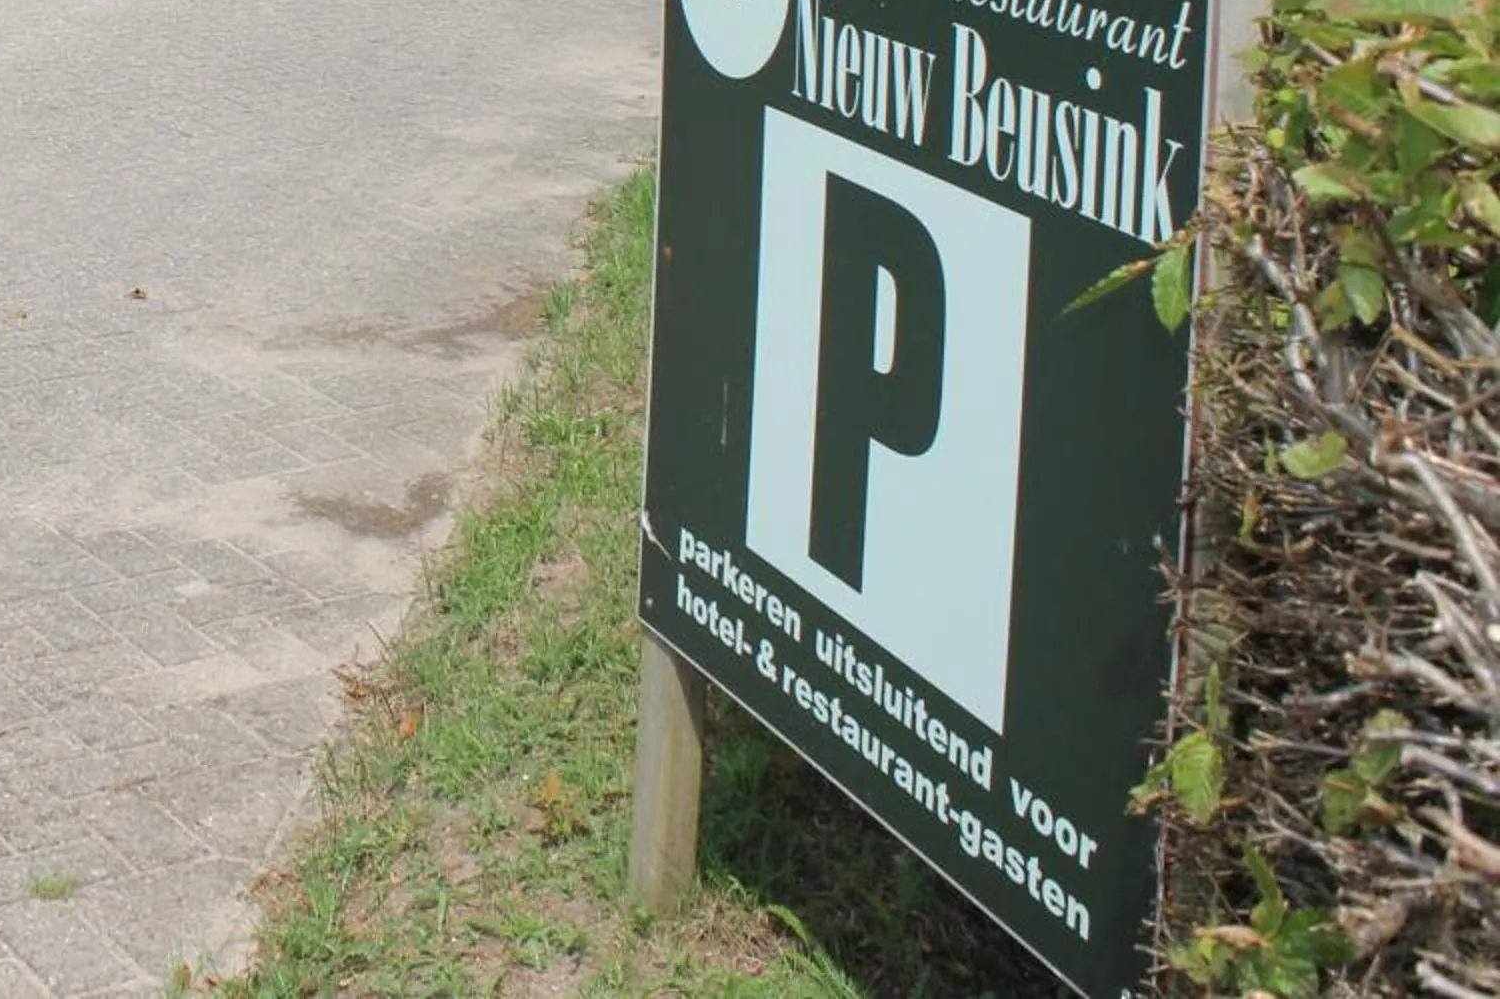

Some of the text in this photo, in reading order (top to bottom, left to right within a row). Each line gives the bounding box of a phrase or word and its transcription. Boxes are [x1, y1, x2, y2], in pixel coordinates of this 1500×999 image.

[948, 21, 1185, 244] Beusink
[808, 170, 947, 595] P
[676, 574, 1091, 942] hotel- & restaurant-gasten
[679, 526, 1098, 869] parkeren uitsluitend voor
